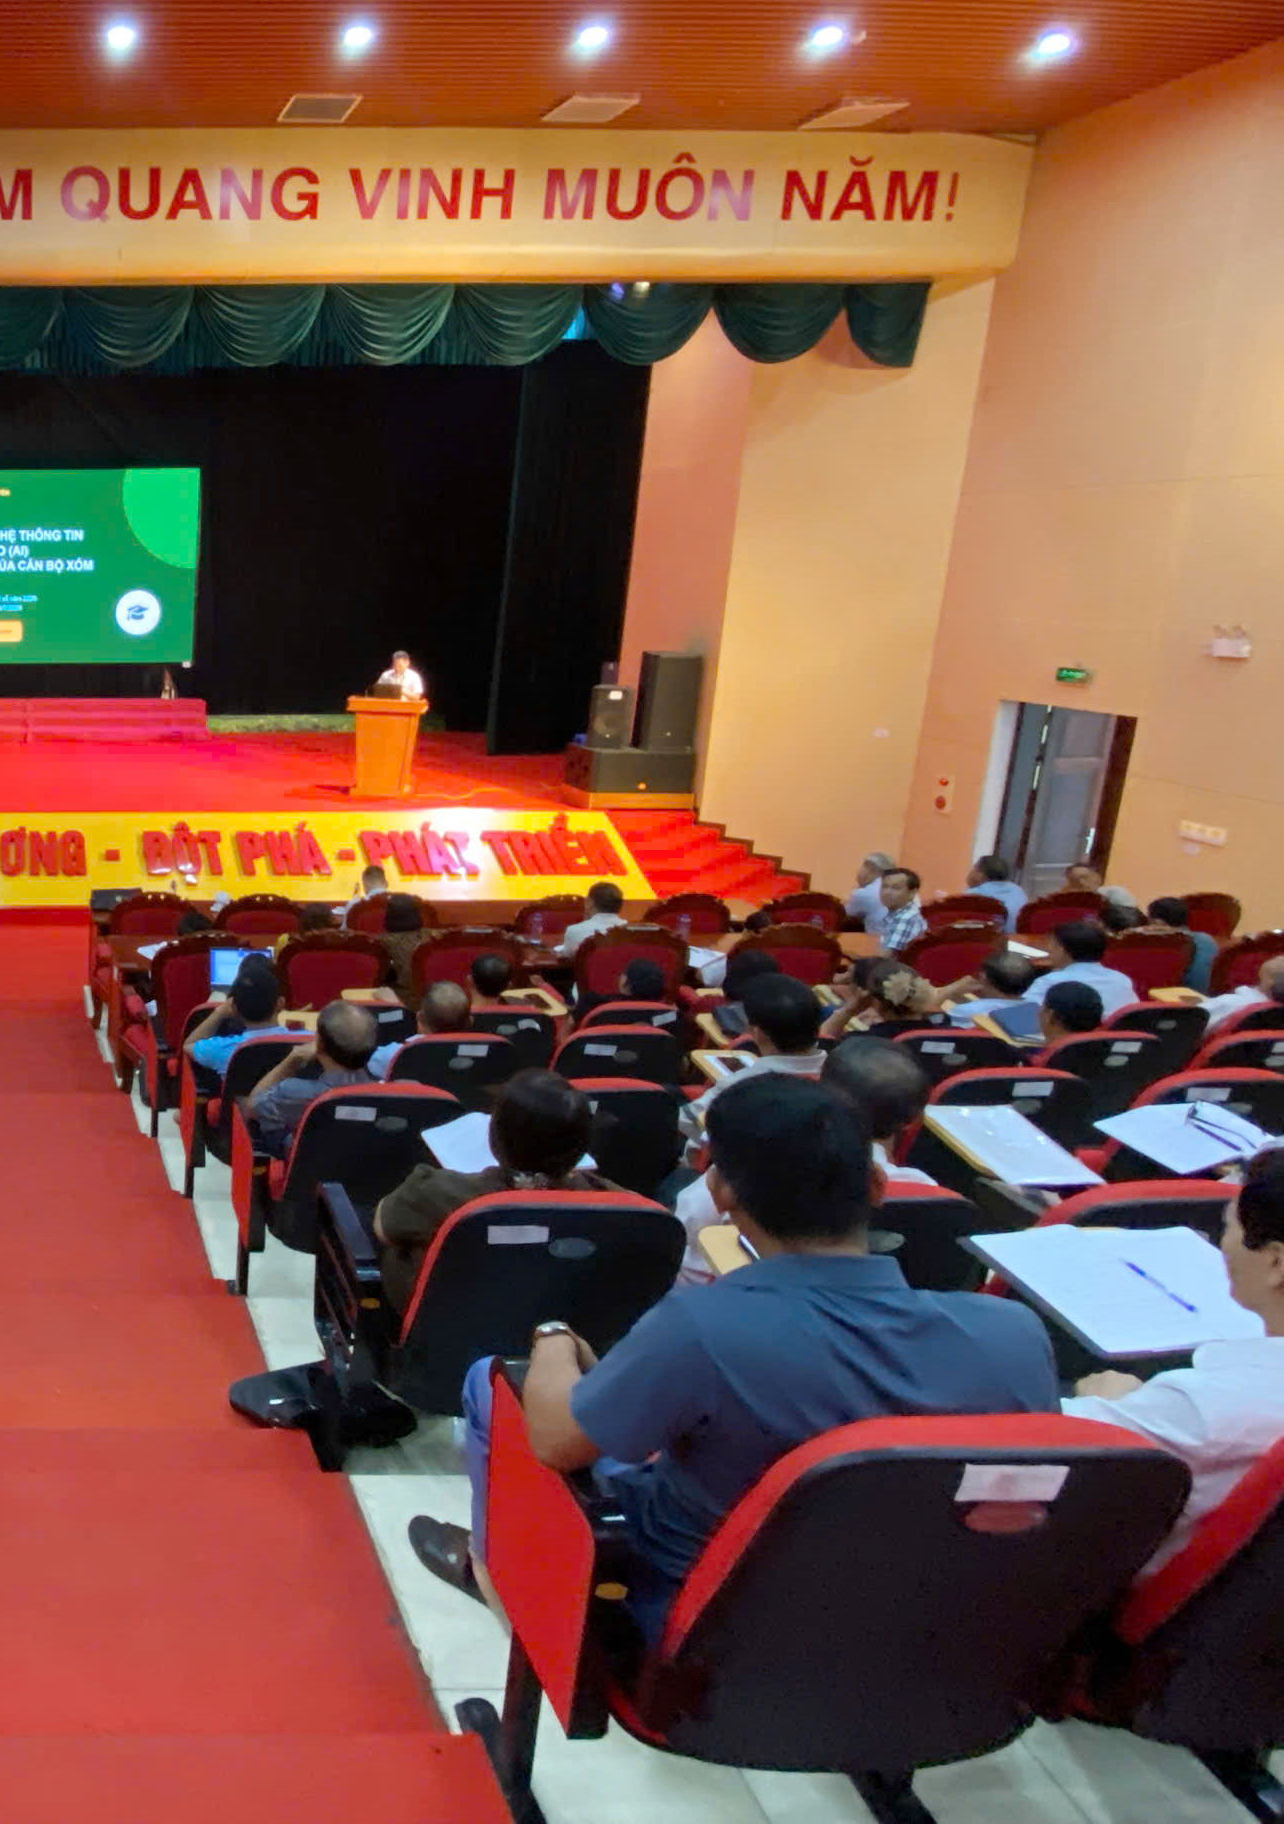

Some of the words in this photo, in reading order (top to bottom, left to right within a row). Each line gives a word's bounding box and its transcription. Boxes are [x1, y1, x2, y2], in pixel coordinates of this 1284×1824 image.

[60, 165, 320, 223] QUANG
[348, 167, 513, 220] VINH
[542, 152, 753, 220] MUÔN
[780, 154, 957, 221] NĂM!
[18, 527, 62, 542] THÔNG
[64, 529, 84, 541] TIN
[8, 545, 30, 559] (AI)
[17, 557, 44, 572] CÁN
[45, 558, 65, 575] BỘ
[66, 557, 95, 572] XÓM
[142, 822, 223, 885] ĐỘT
[238, 822, 333, 876] PHÁ
[361, 822, 479, 876] PHÁT
[482, 813, 628, 876] TRIỂN
